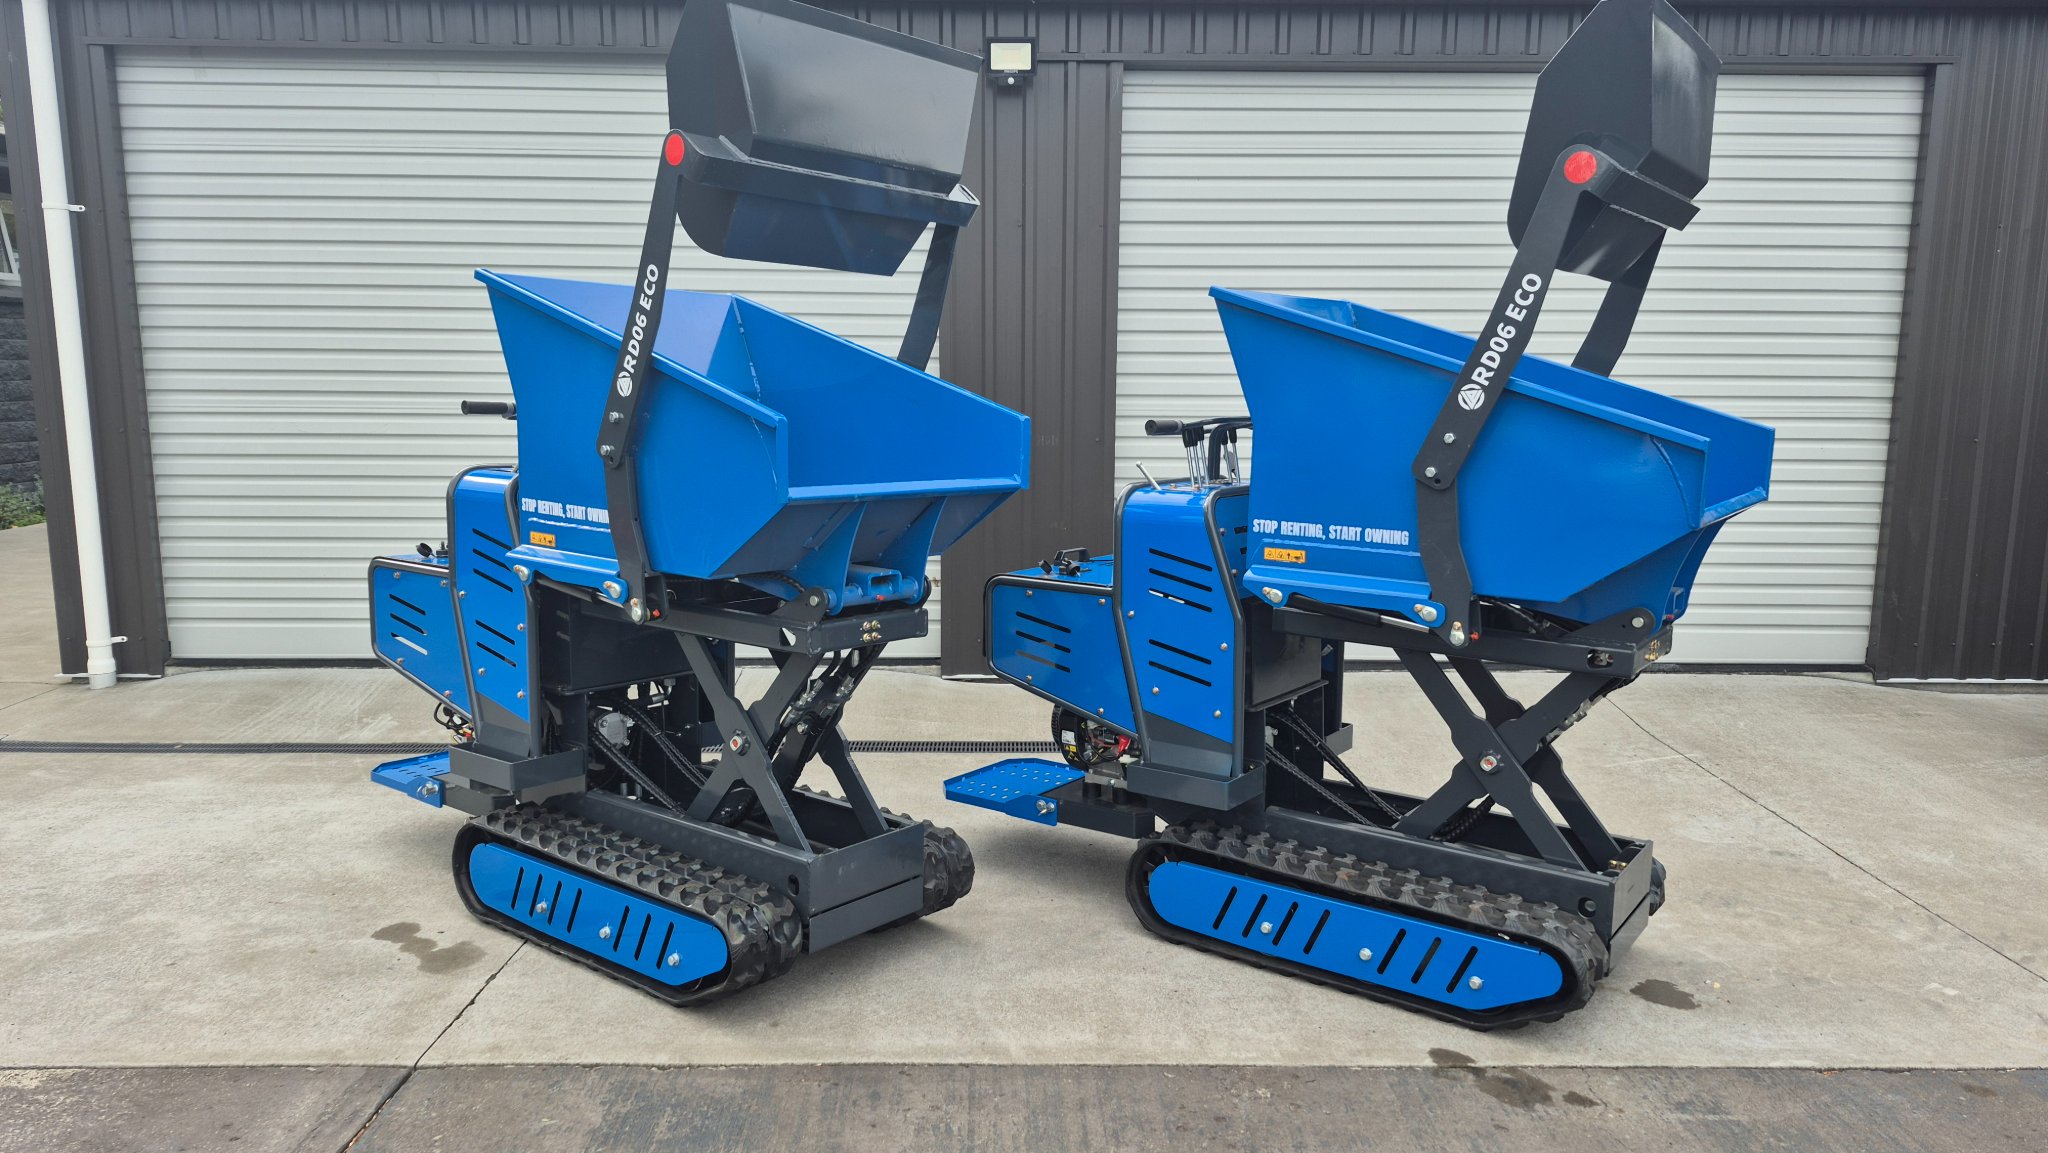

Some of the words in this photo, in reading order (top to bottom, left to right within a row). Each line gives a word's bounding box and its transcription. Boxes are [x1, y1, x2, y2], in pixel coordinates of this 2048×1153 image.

[623, 311, 647, 374] RD06
[639, 263, 659, 311] ECO
[1470, 322, 1516, 387] RD06
[1504, 273, 1542, 322] ECO
[521, 498, 537, 512] STOP
[566, 504, 586, 520] START
[587, 507, 609, 524] OWNIN
[1252, 519, 1278, 534] STOP
[1280, 521, 1326, 540] RENTING,
[1328, 525, 1362, 541] START
[1364, 528, 1409, 545] OWNING
